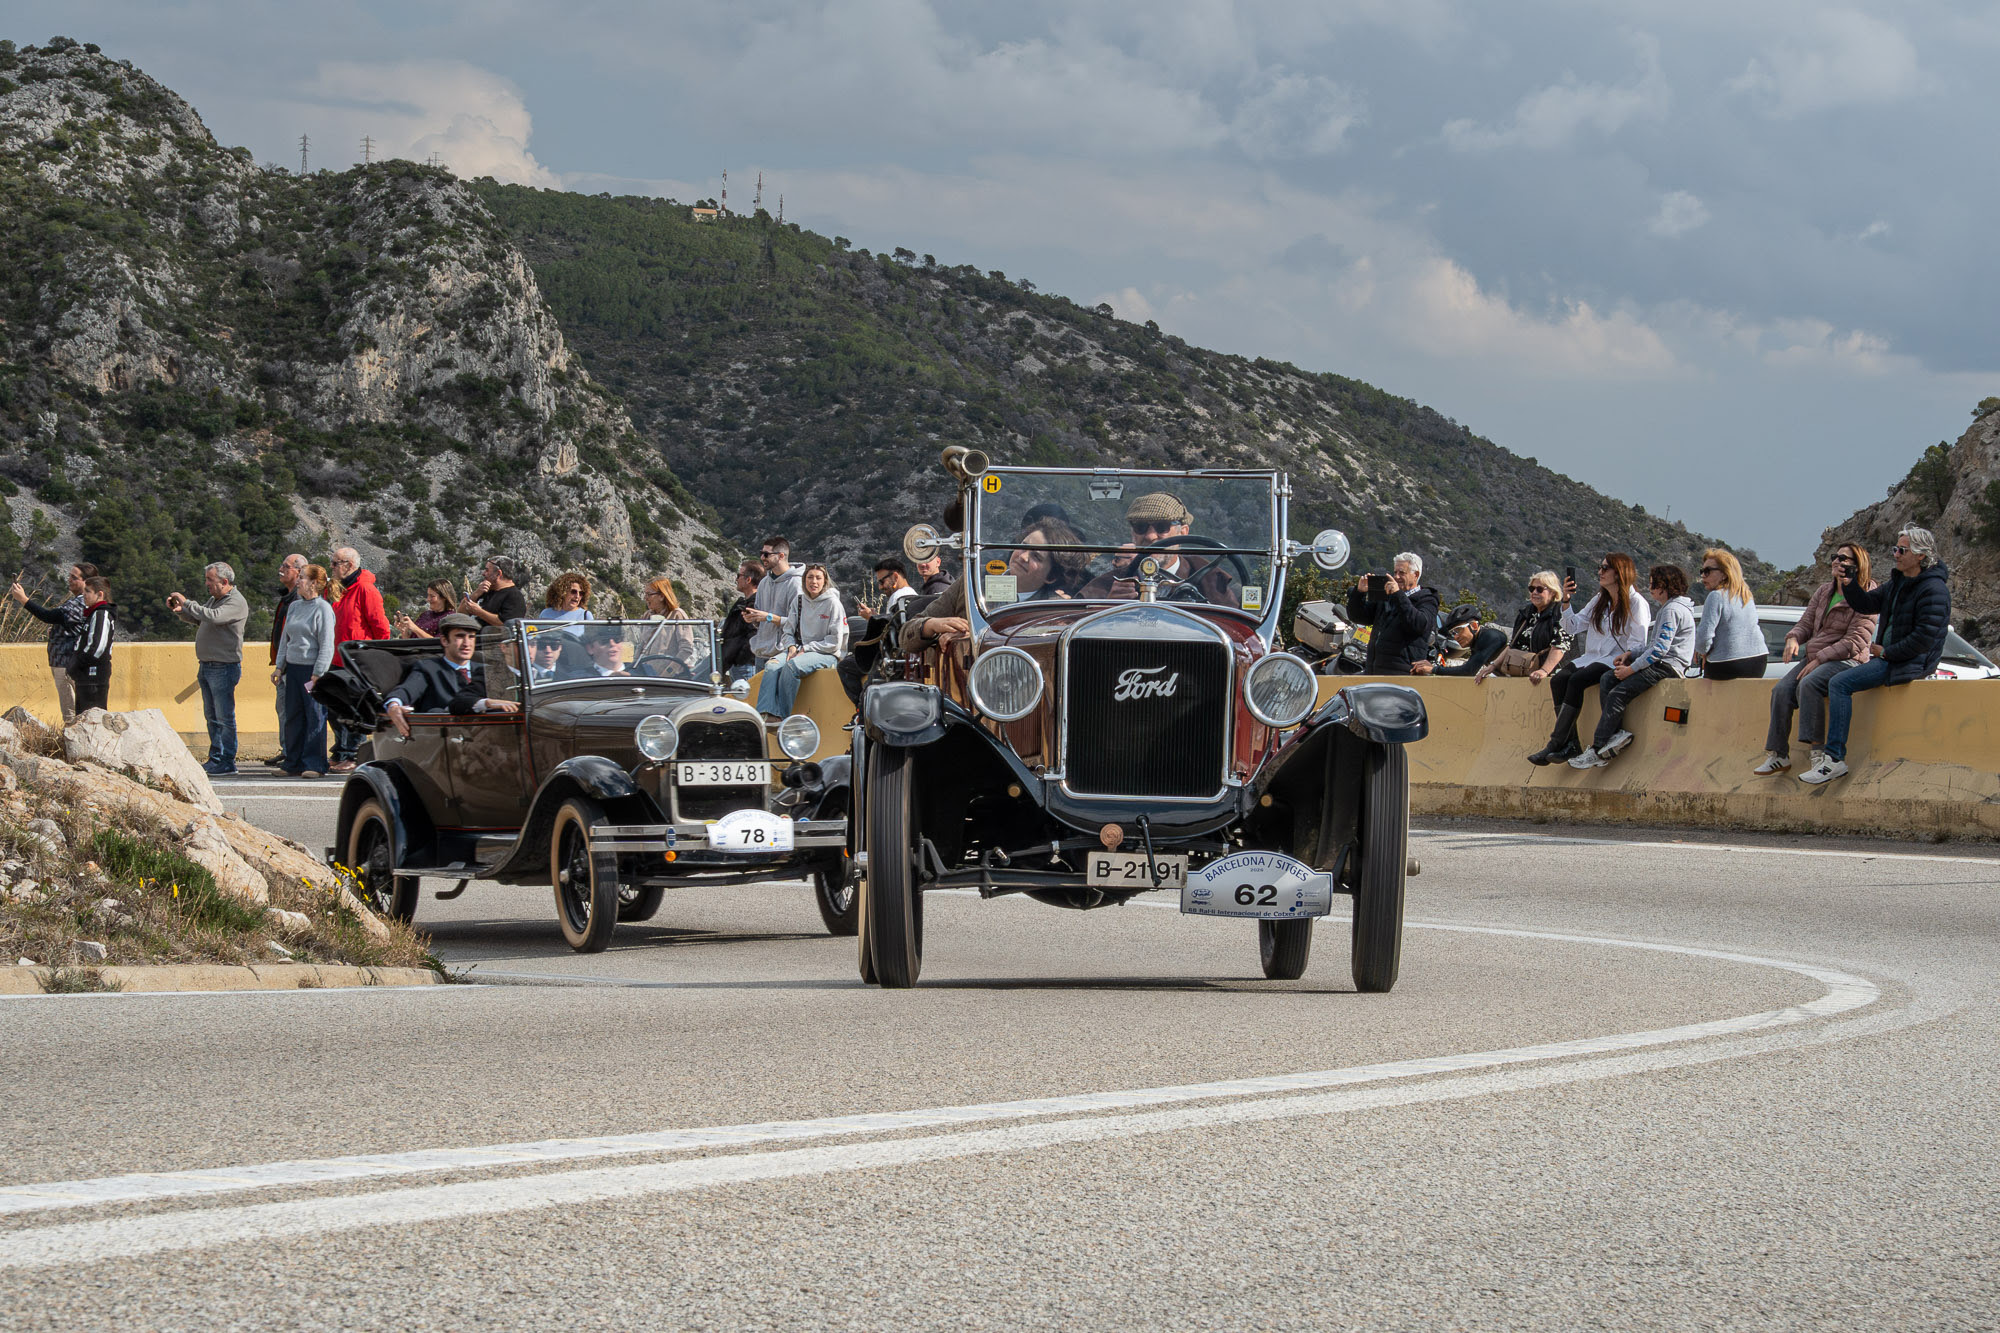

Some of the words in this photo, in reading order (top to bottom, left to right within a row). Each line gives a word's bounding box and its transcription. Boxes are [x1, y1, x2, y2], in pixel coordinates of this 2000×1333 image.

[987, 478, 998, 490] H
[1114, 665, 1179, 702] Ford
[684, 765, 766, 782] B-38481
[740, 828, 765, 844] 78
[1204, 856, 1265, 882] BARCELONA
[1275, 860, 1309, 882] SITGES
[1234, 883, 1278, 907] 62
[1217, 909, 1261, 917] Internacional
